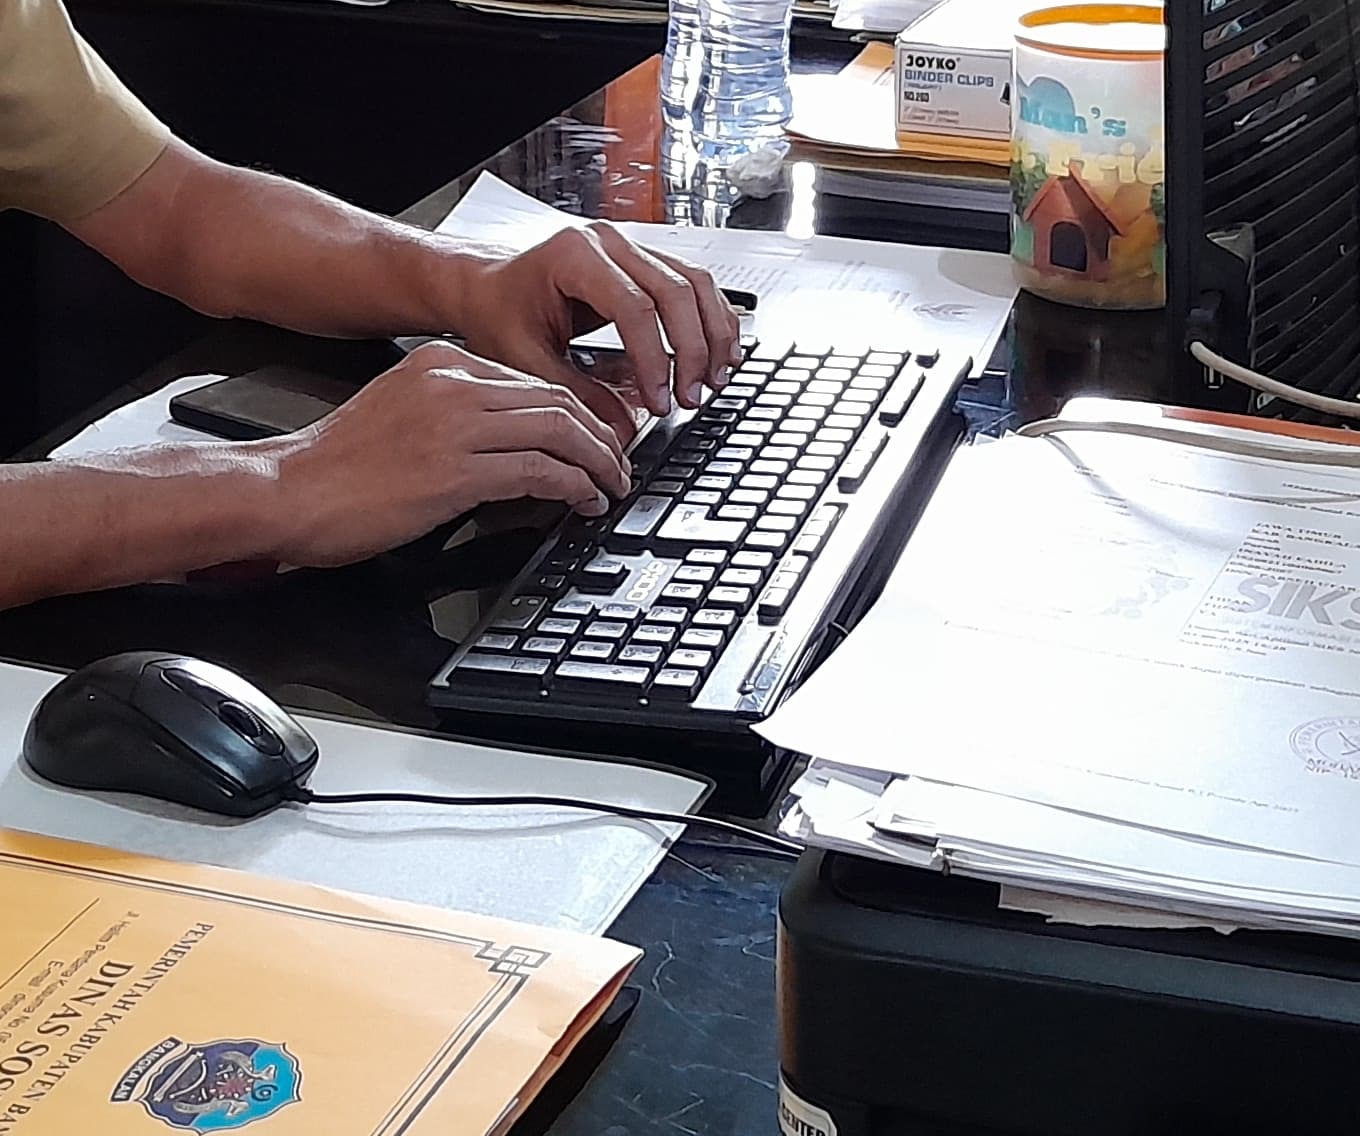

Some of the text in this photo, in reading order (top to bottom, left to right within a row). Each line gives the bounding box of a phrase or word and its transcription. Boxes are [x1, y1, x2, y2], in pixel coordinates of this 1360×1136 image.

[905, 70, 993, 87] BINDER CLIPS
[906, 54, 956, 71] JOYKO
[37, 959, 135, 1039] DINAS
[112, 921, 215, 1012] PEMERINTAH
[22, 1012, 123, 1102] KABUPATEN
[113, 1039, 177, 1101] BANGKALAN
